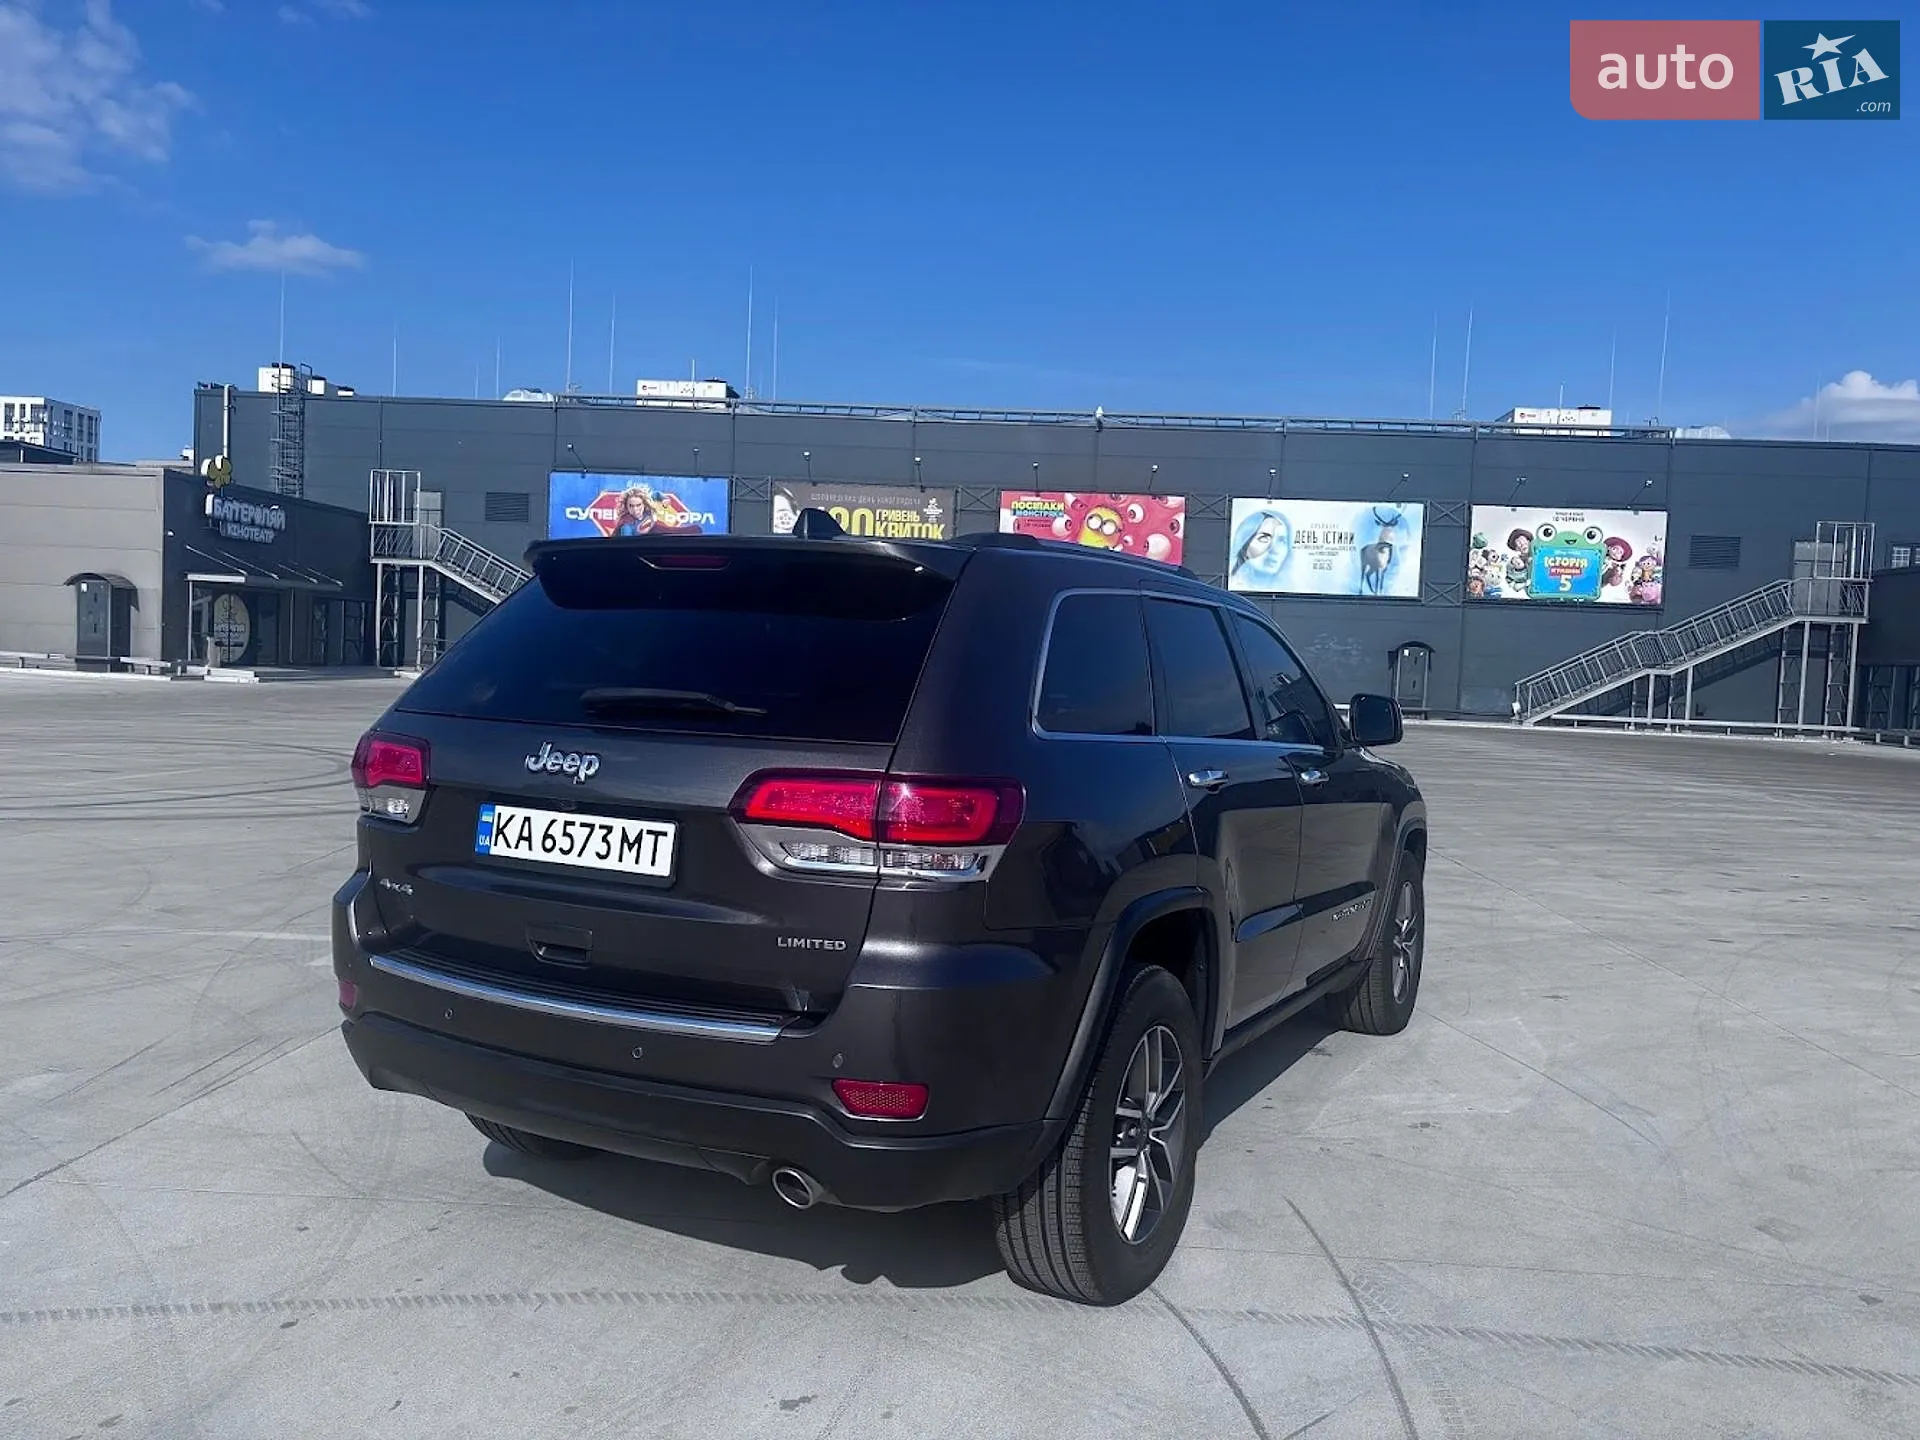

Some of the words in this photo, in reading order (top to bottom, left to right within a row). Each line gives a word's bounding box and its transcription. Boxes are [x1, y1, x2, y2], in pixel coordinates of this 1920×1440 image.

[875, 508, 920, 522] ГРИВЕНЬ
[226, 521, 275, 544] КІНОТЕАТР
[874, 520, 945, 540] КВИТОК
[1294, 529, 1319, 545] ДЕНЬ
[1322, 530, 1354, 546] ІСТИНИ
[1544, 555, 1588, 568] ІСТОРІЯ
[1559, 574, 1572, 592] 5
[525, 741, 600, 785] Jeep
[478, 834, 491, 847] UA
[493, 812, 534, 851] KA
[541, 818, 614, 860] 6573
[618, 826, 668, 867] MT
[777, 936, 847, 951] LIMITED
